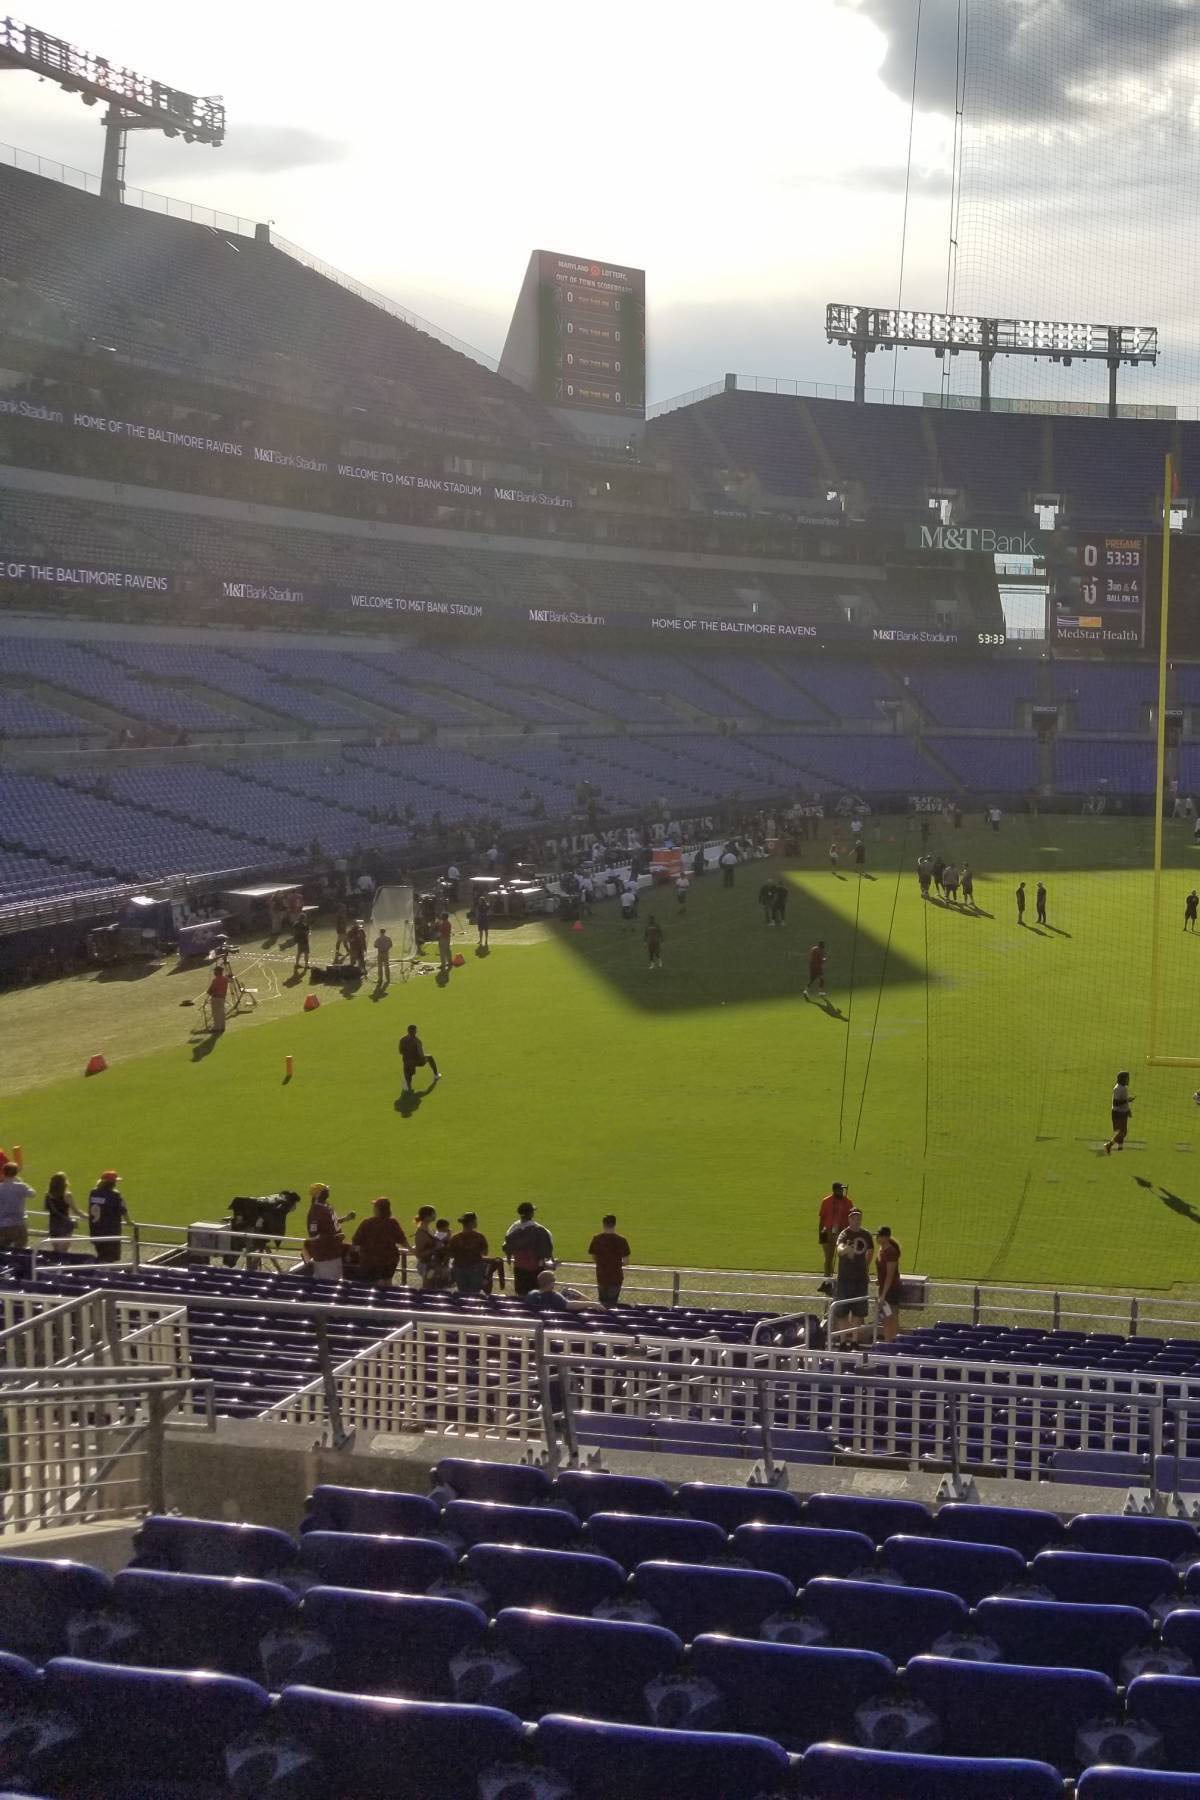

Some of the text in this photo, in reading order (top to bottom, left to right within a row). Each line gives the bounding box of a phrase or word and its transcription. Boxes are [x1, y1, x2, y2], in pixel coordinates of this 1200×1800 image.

[556, 273, 568, 283] OUT
[569, 276, 578, 285] OF
[0, 401, 64, 424] ank Stadium
[73, 413, 243, 456] HOME OF THE BALTIMORE RAVENS
[254, 447, 328, 472] M&T Bank Stadium
[338, 464, 482, 496] WELCOME TO M&T BANK STADIUM
[494, 487, 573, 508] M&T Bank Stadium
[920, 525, 1036, 553] M&T Bank
[1084, 544, 1098, 566] 0
[1106, 551, 1140, 566] 53:33
[7, 563, 27, 578] OF
[29, 564, 54, 581] THE
[57, 568, 123, 586] BALTIMORE
[124, 574, 168, 590] RAVENS
[223, 582, 304, 601] M&T Bank Stadium
[351, 595, 482, 616] WELCOME TO M&T BANK STADIUM
[529, 609, 605, 625] M&T Bank Stadium
[651, 618, 817, 636] HOME OF THE BALTIMORE RAVENS
[872, 629, 958, 643] M&T Bank Stadium
[977, 633, 1005, 645] 53:33
[1057, 628, 1138, 641] MedStar Health
